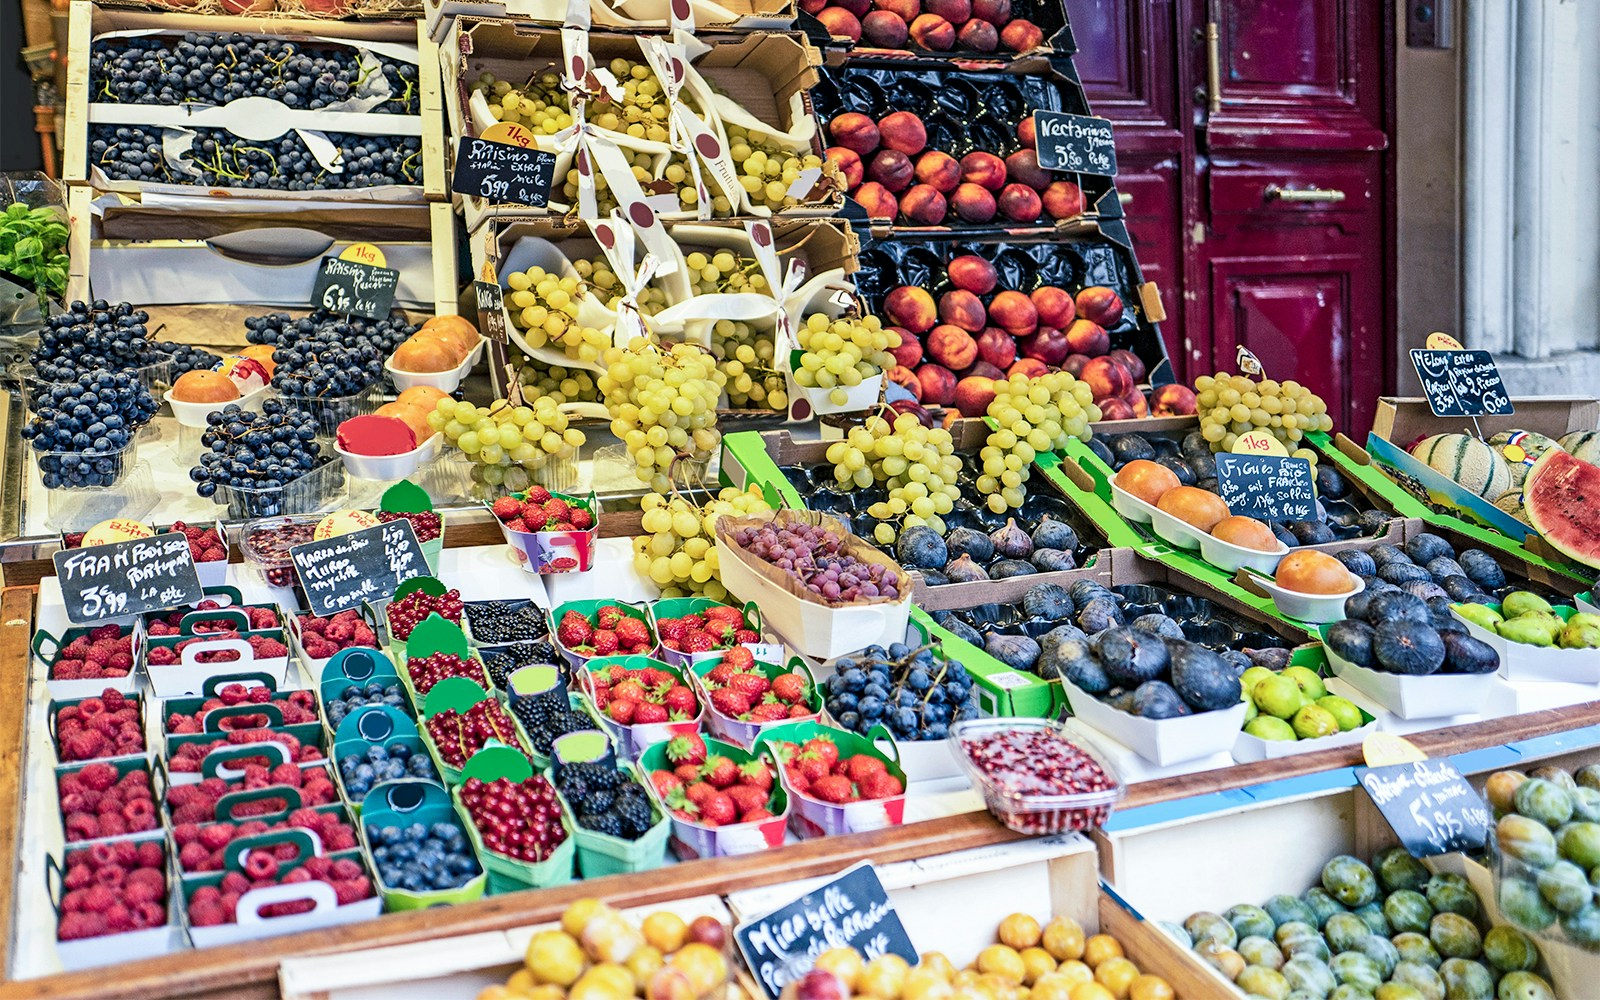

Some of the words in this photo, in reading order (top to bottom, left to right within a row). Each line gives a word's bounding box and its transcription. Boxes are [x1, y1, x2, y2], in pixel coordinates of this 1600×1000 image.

[507, 125, 531, 148] 1kg
[356, 246, 376, 262] 1kg
[1466, 377, 1481, 396] 2
[1243, 435, 1270, 451] 1kg
